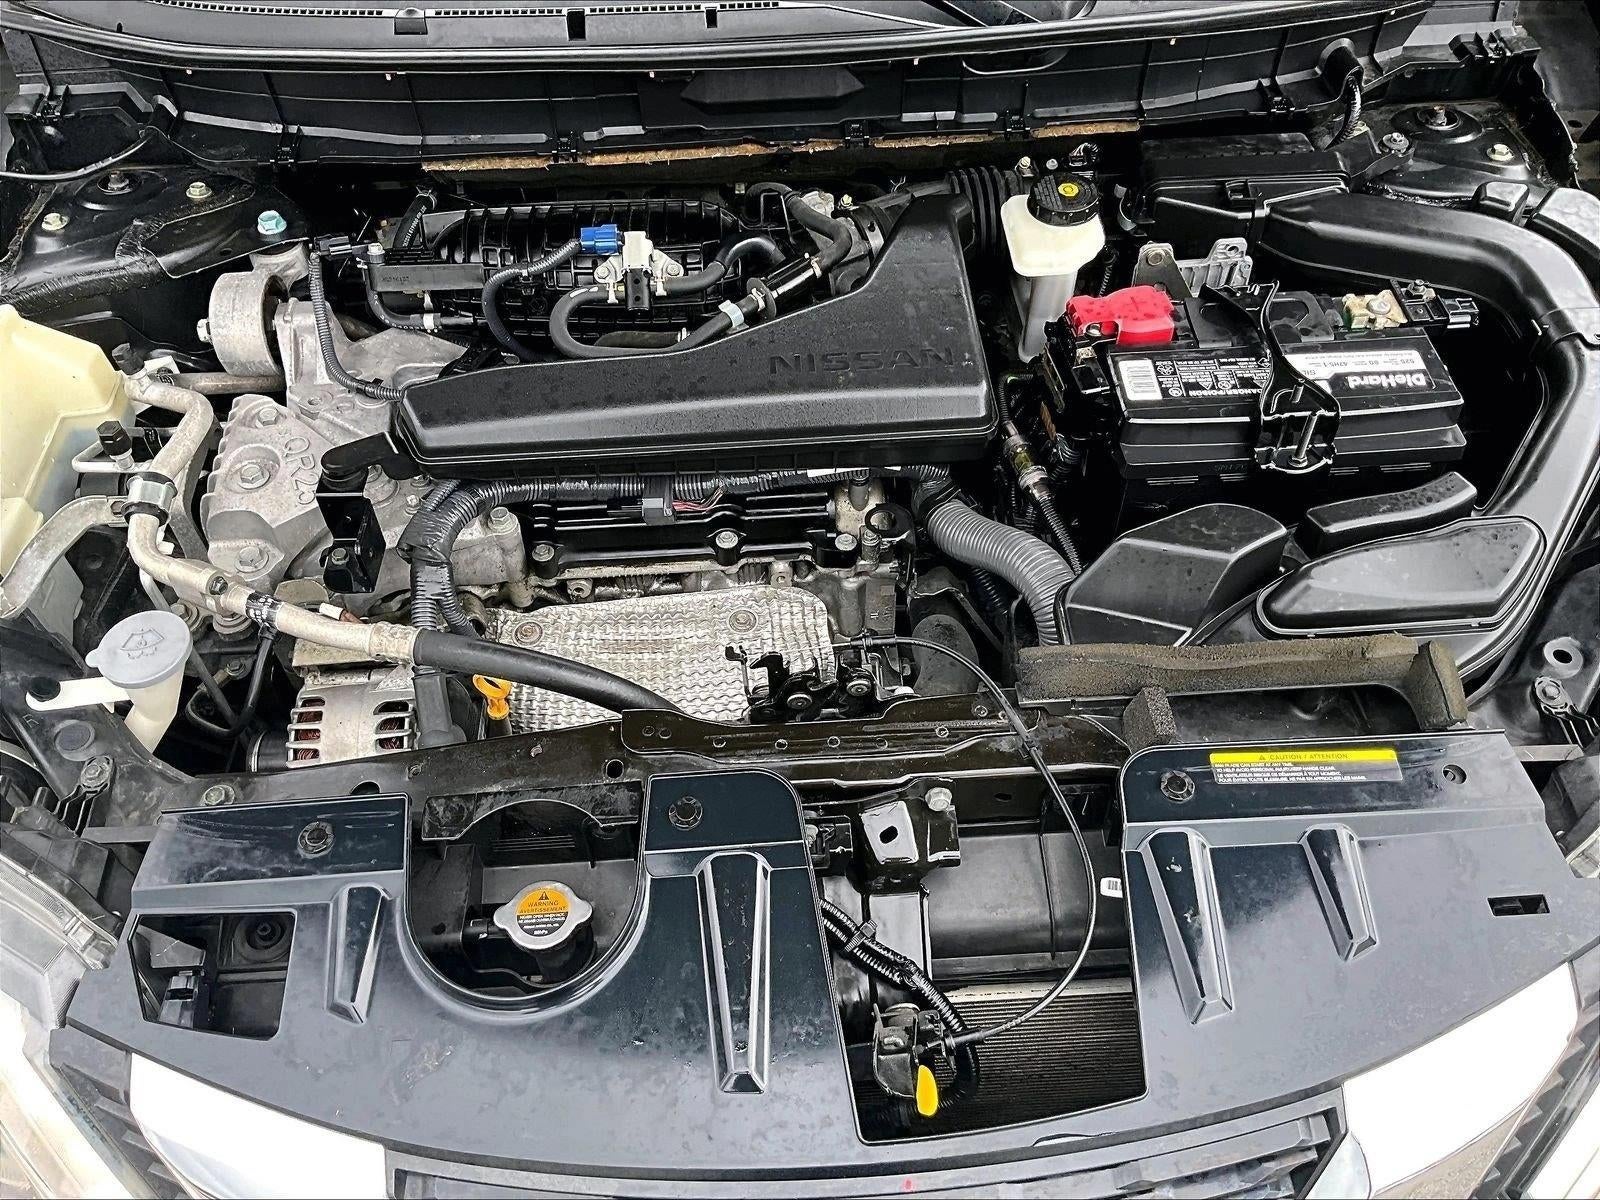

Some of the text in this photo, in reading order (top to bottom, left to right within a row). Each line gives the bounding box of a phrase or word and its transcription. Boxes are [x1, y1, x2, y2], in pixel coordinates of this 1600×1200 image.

[769, 347, 955, 375] NISSAN
[1345, 373, 1427, 389] DieHard
[282, 436, 320, 505] QR25
[520, 906, 565, 914] AVERTISSEMENT
